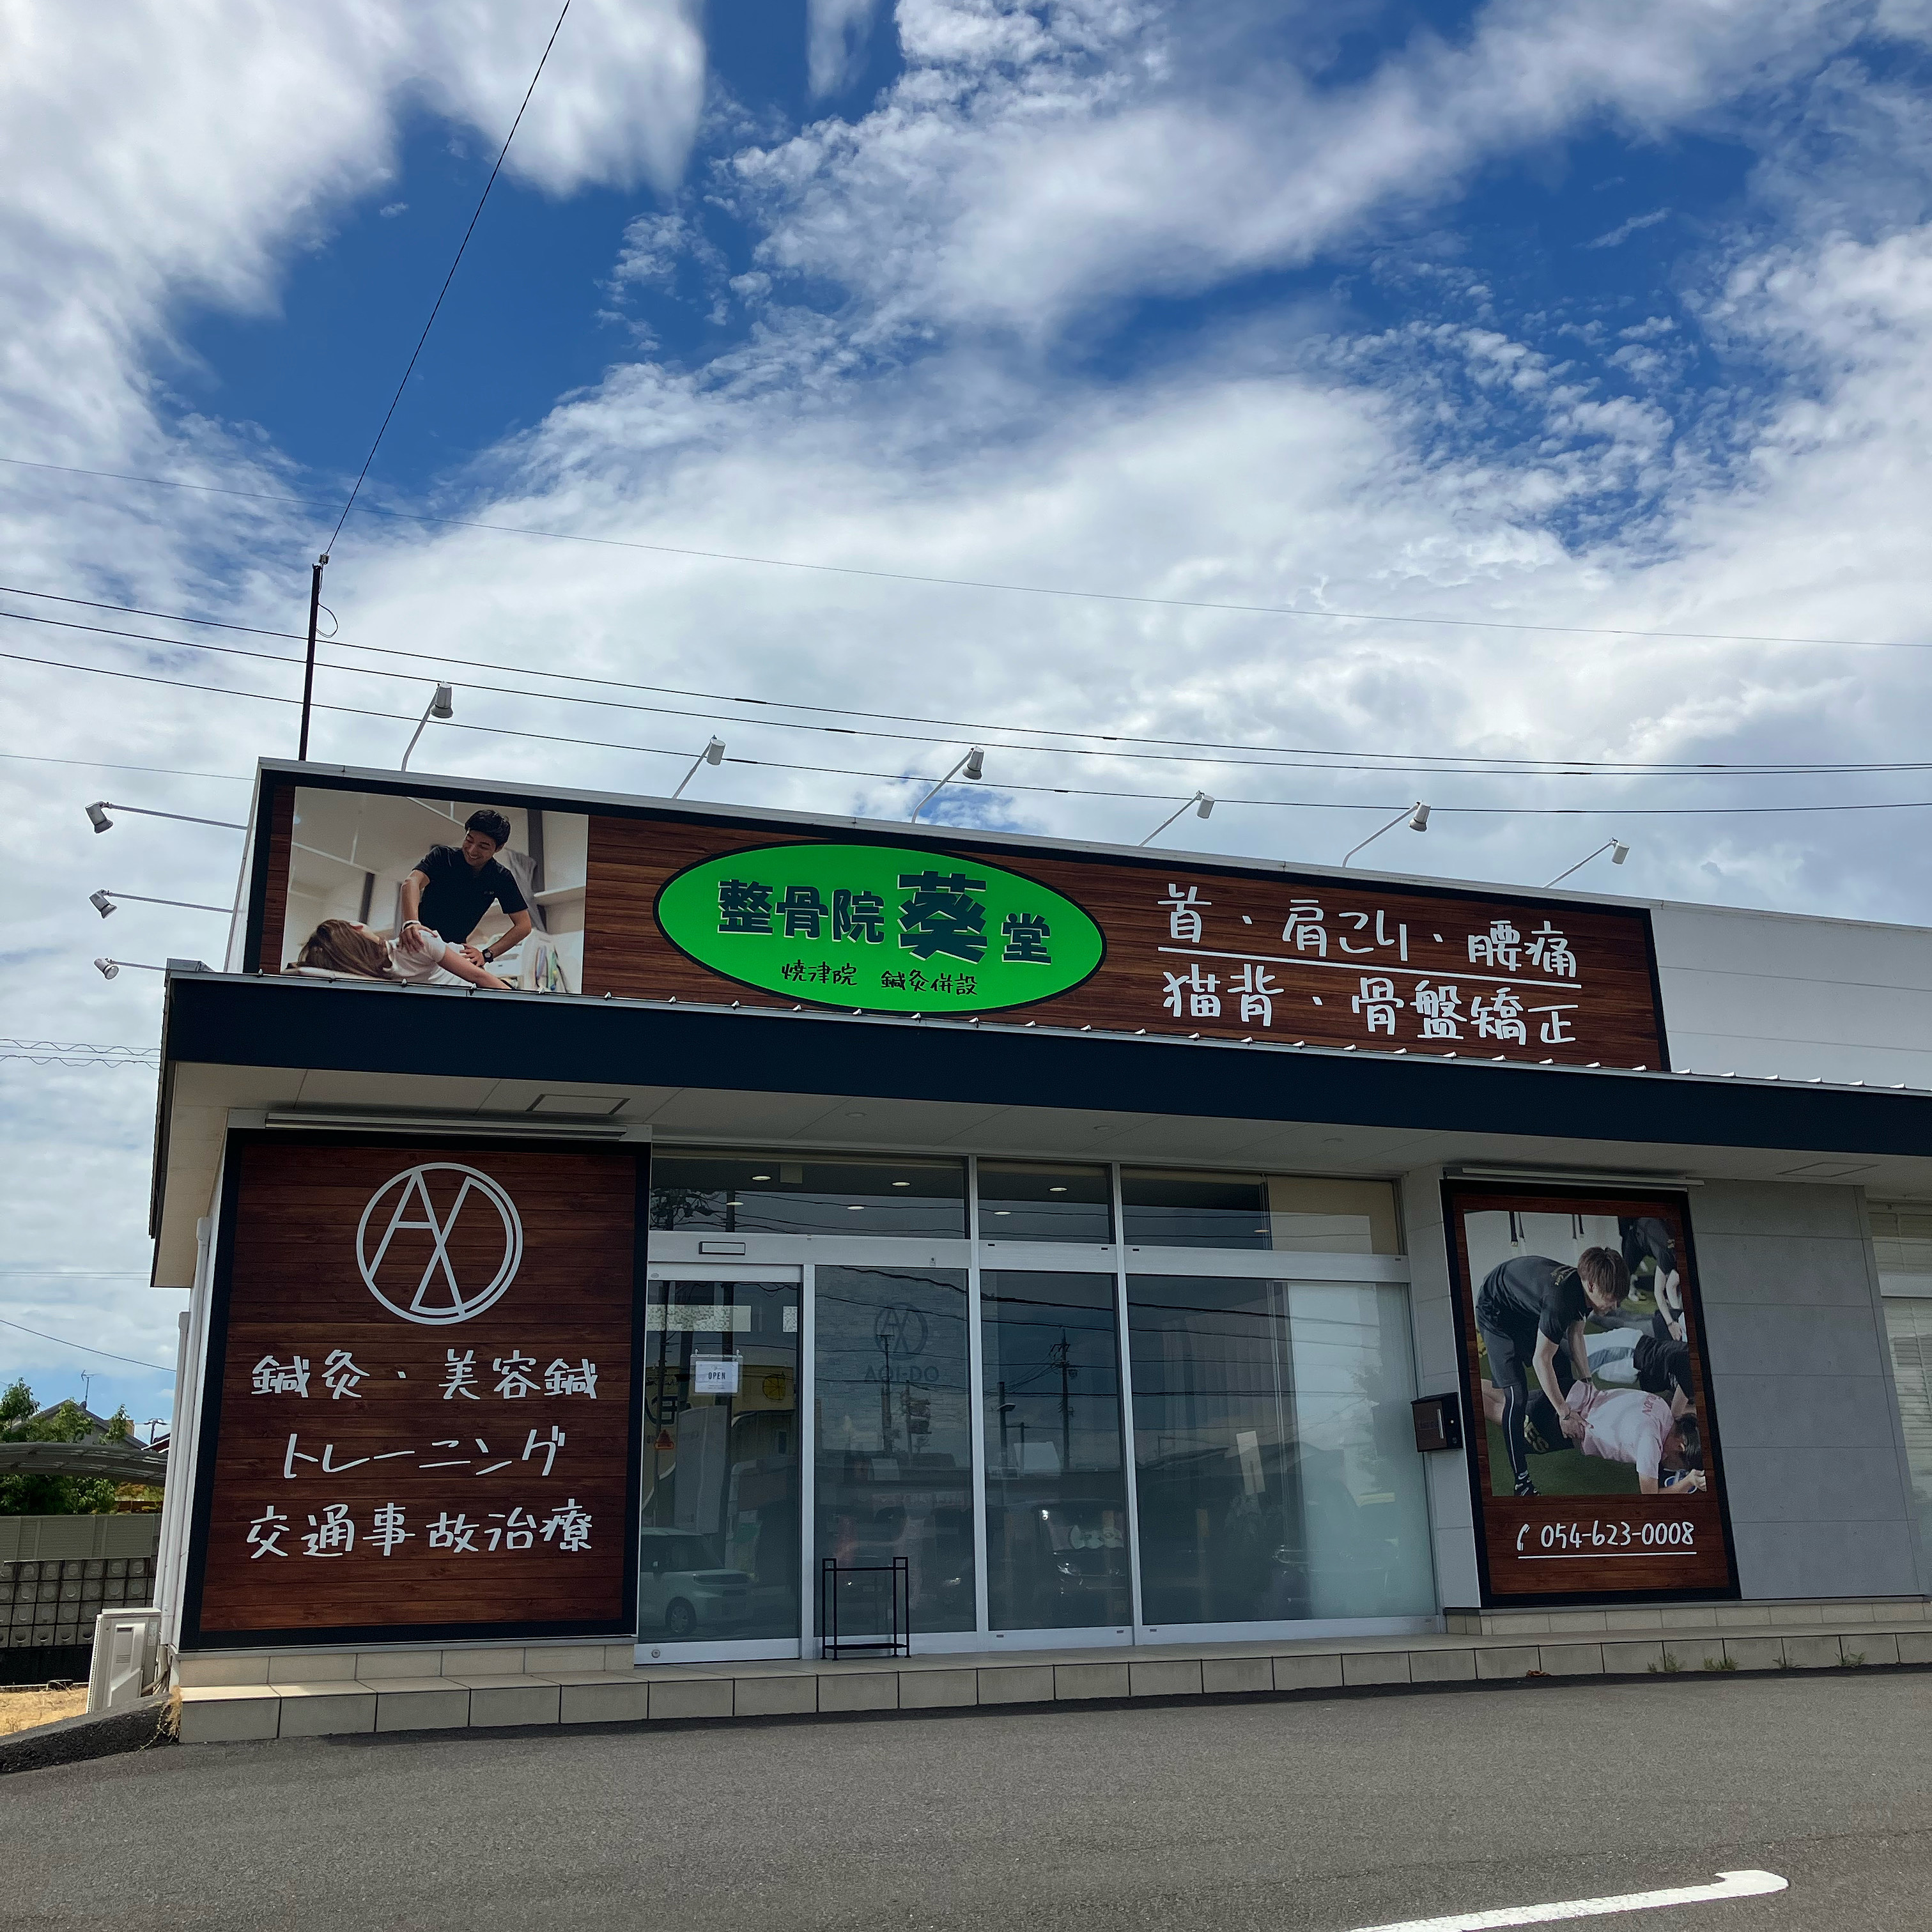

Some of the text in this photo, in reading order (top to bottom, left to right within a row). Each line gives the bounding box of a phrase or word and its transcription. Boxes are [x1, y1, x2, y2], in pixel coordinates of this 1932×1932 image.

[781, 959, 978, 996] 焼津院 鍼灸併設
[708, 1372, 726, 1380] OPEN
[283, 1425, 566, 1478] トレーニング
[245, 1499, 592, 1559] 交通事故治療
[1541, 1520, 1694, 1549] 054-623-0008
